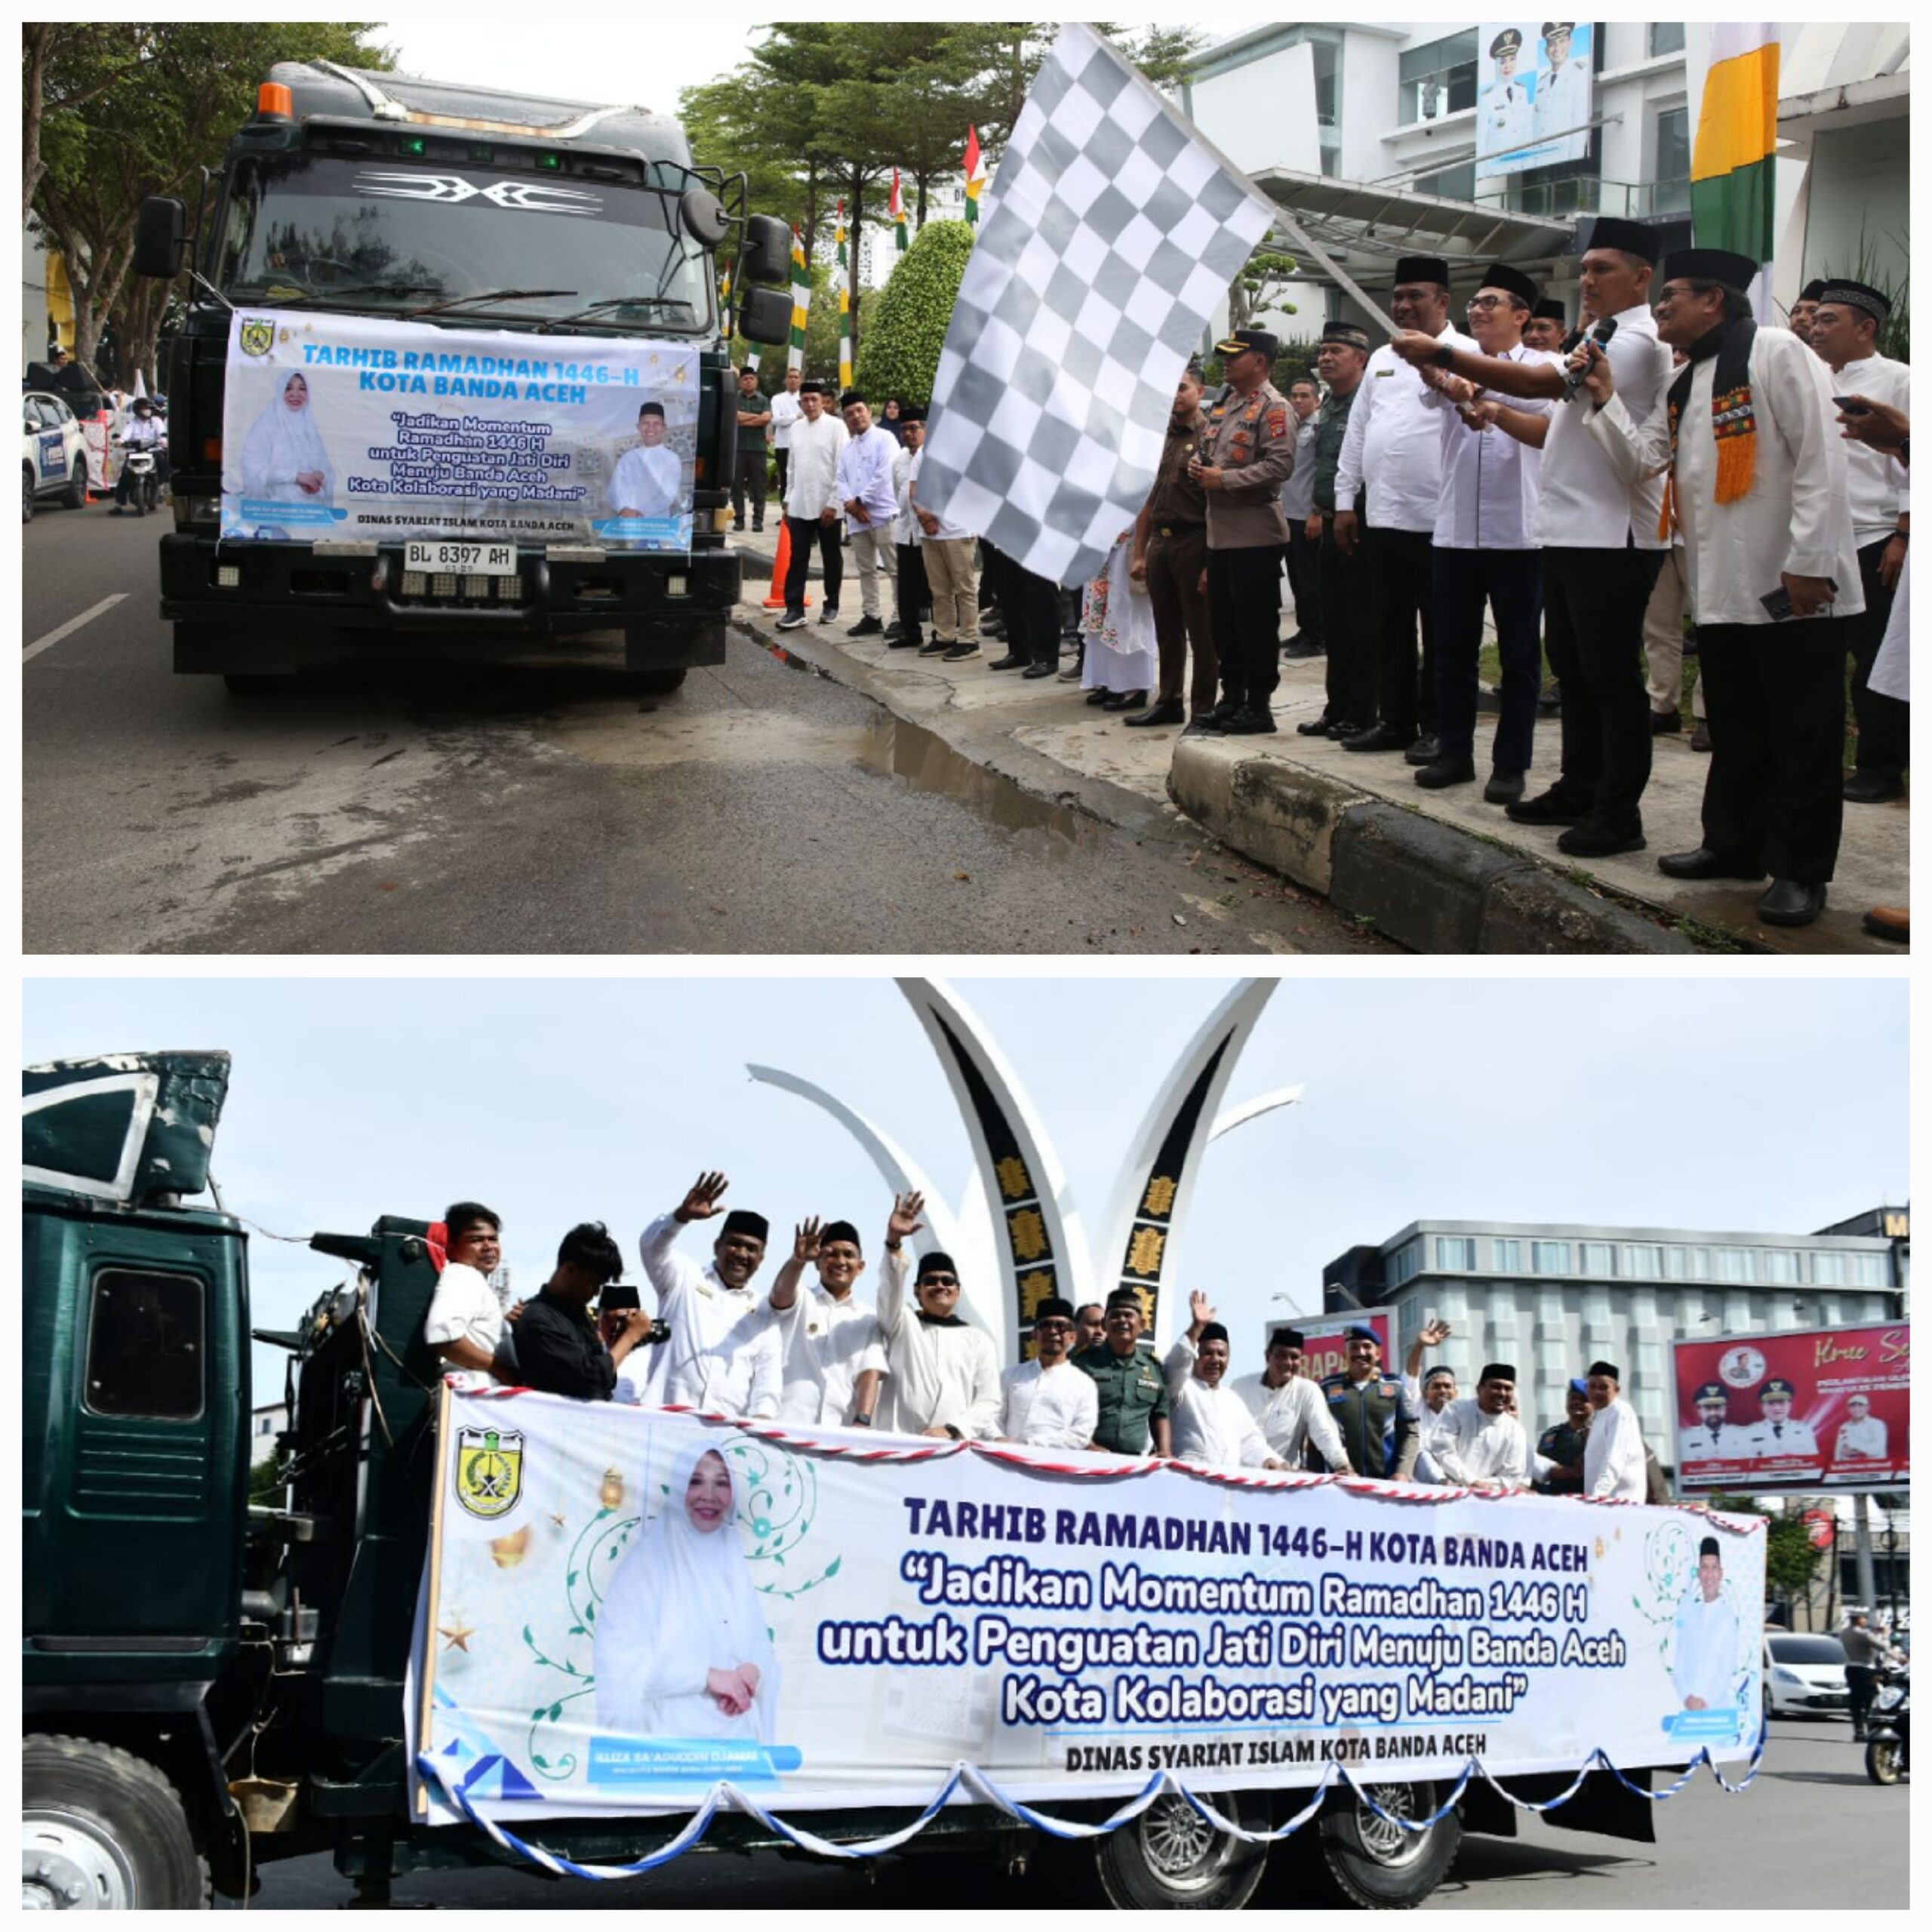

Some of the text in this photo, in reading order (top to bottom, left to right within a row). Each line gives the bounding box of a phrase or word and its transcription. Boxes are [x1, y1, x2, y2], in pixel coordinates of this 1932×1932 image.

[303, 344, 638, 386] TARHIB RAMADHAN 1446-H
[359, 371, 586, 405] KOTA BANDA ACEH
[463, 417, 552, 435] Momentum
[398, 430, 545, 451] Ramadhan 1446 H
[369, 448, 570, 469] untuk Penguatan Jati Diri
[391, 463, 547, 484] Menuju Banda Aceh
[349, 477, 389, 493] Kota
[392, 480, 478, 497] Kolaborasi
[479, 485, 518, 500] yang
[358, 515, 574, 531] DINAS SYARIAT ISLAM KOTA BANDA ACEH
[410, 546, 509, 565] BL 8397 AH
[904, 1497, 1588, 1572] TARHIB RAMADHAN 1446-H KOTA BANDA ACEH
[1101, 1561, 1312, 1615] Momentum
[1321, 1573, 1483, 1620] Ramadhan
[1490, 1580, 1559, 1621] 1446
[1563, 1583, 1588, 1622] H
[818, 1613, 1626, 1676] untuk Penguatan Jati Diri Menuju Banda Aceh
[1002, 1673, 1106, 1725] Kota
[1114, 1672, 1315, 1724] Kolaborasi
[1323, 1681, 1401, 1724] yang
[1066, 1734, 1486, 1771] DINAS SYARIAT ISLAM KOTA BANDA ACEH
